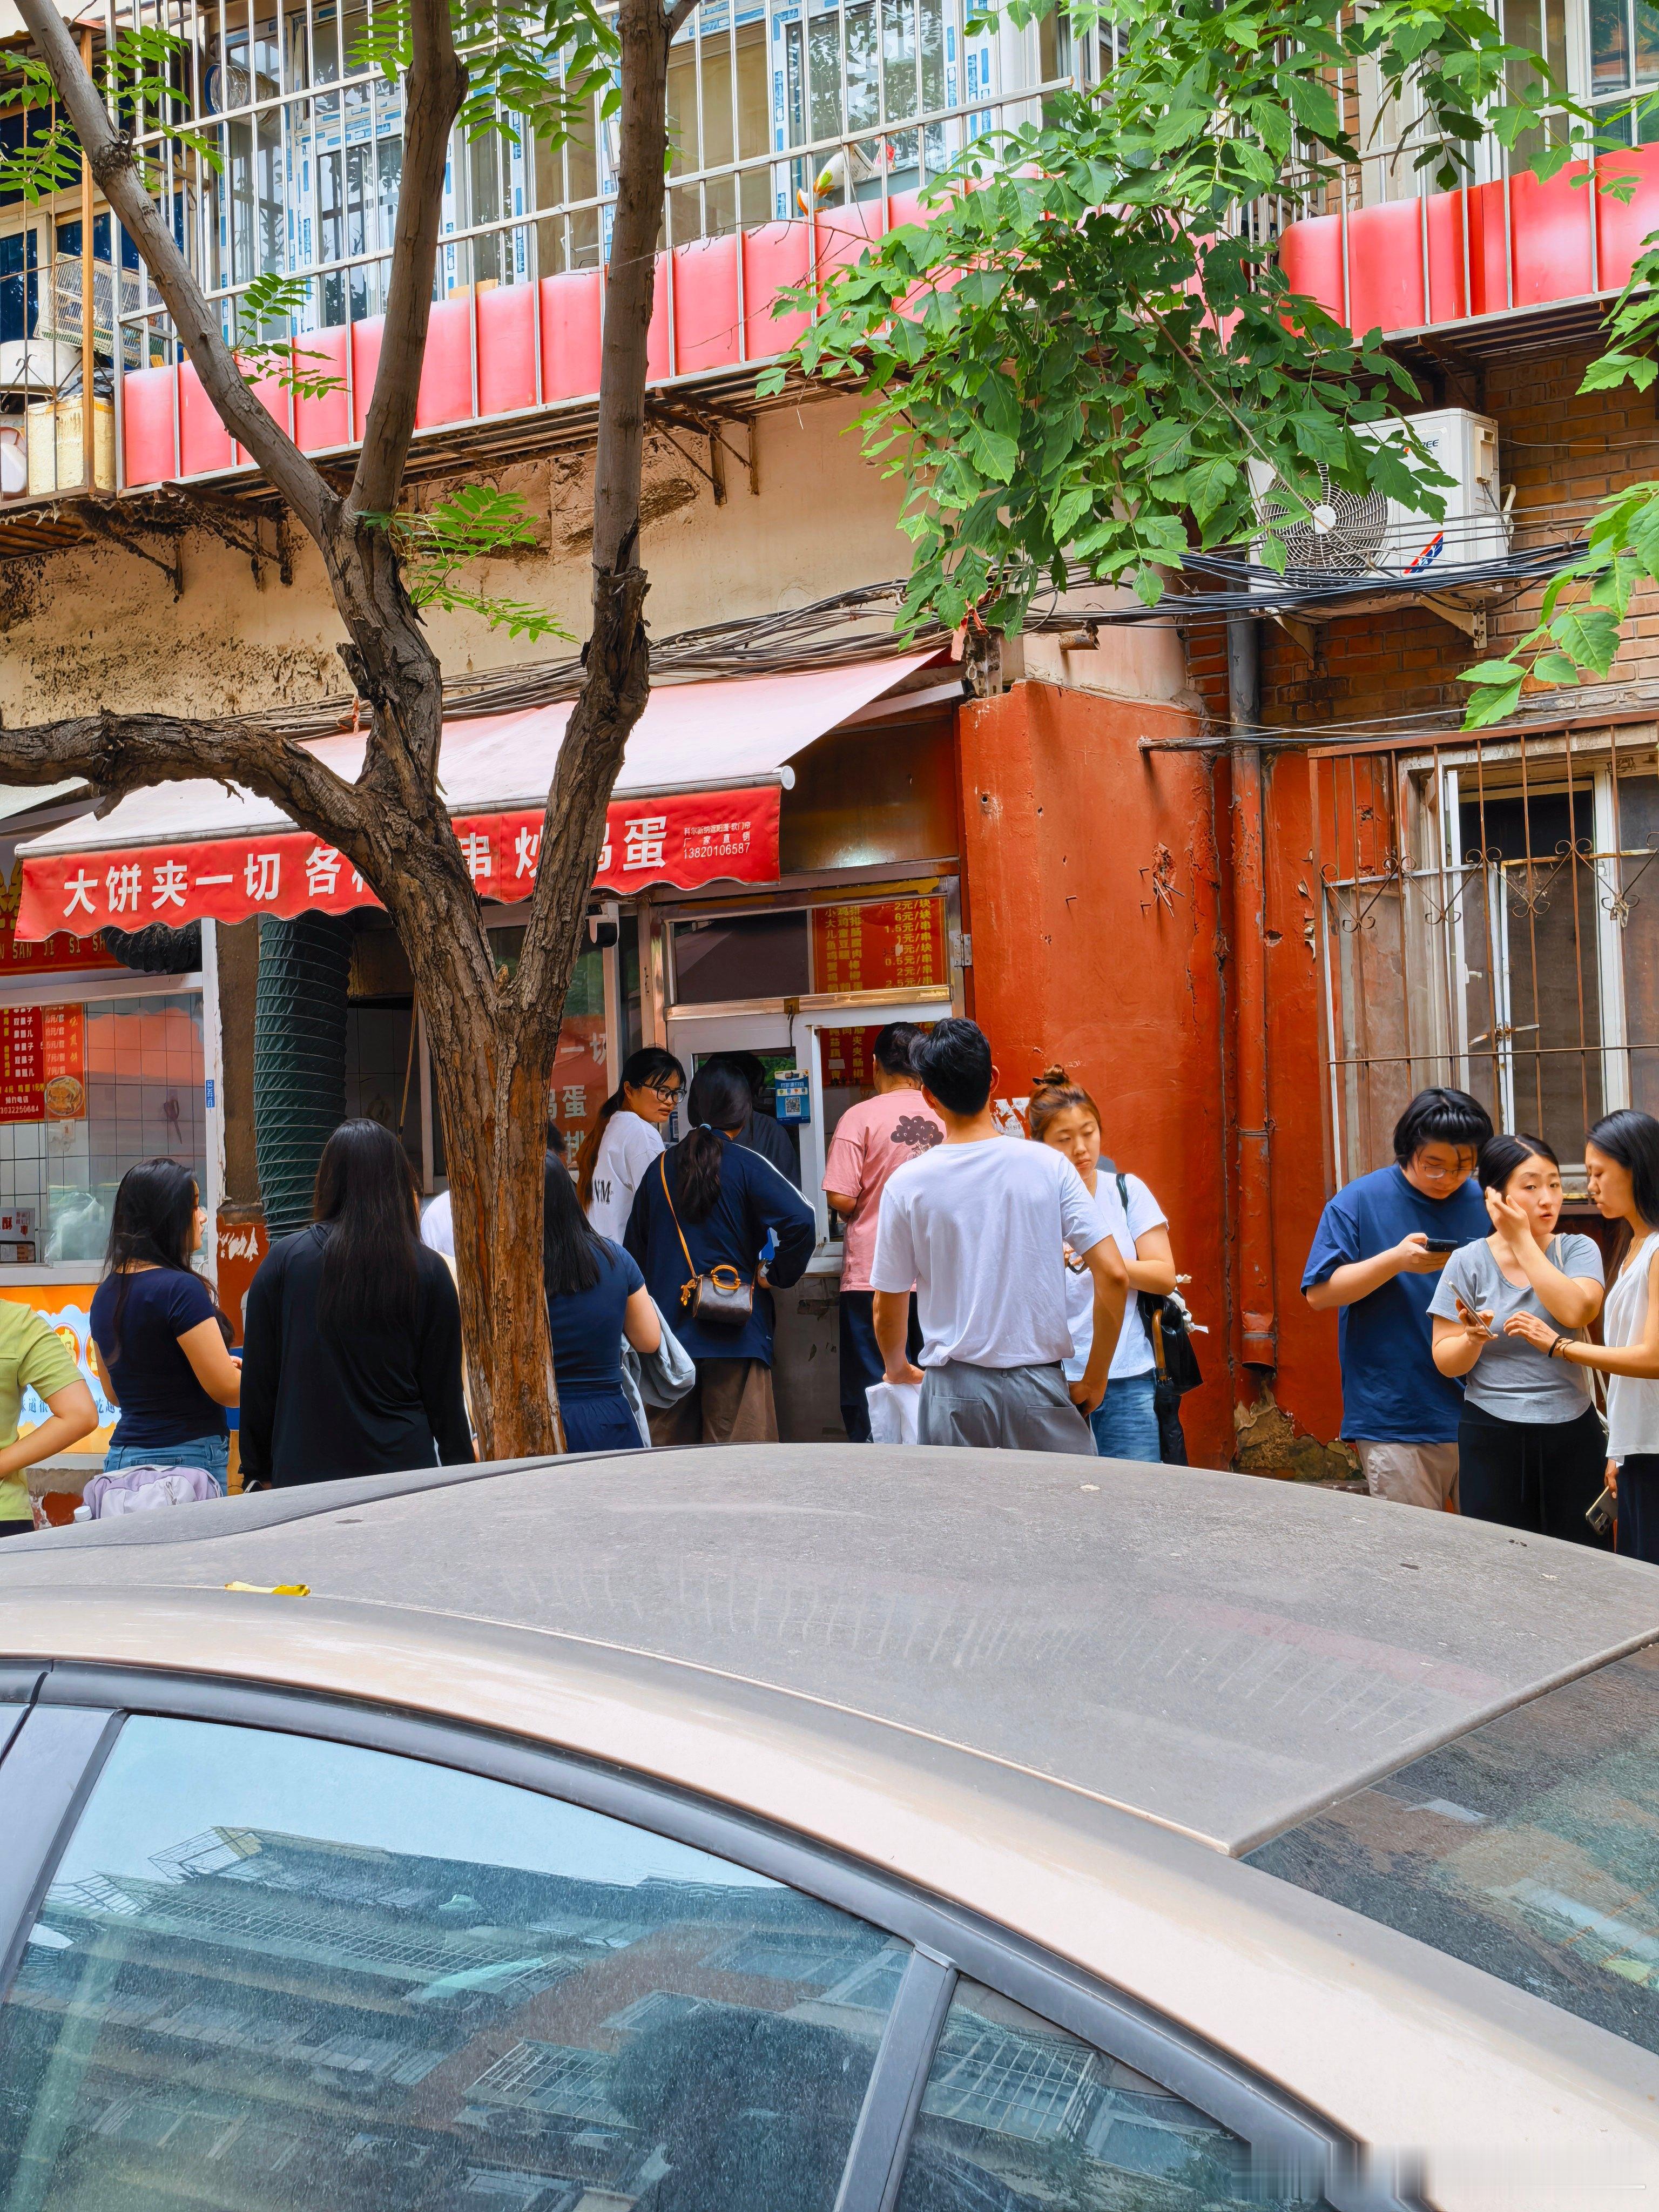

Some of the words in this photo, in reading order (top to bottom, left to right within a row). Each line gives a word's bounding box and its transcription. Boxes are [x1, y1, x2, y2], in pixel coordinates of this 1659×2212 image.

[684, 842, 750, 859] 13820106587
[63, 853, 280, 918] 大饼夹一切
